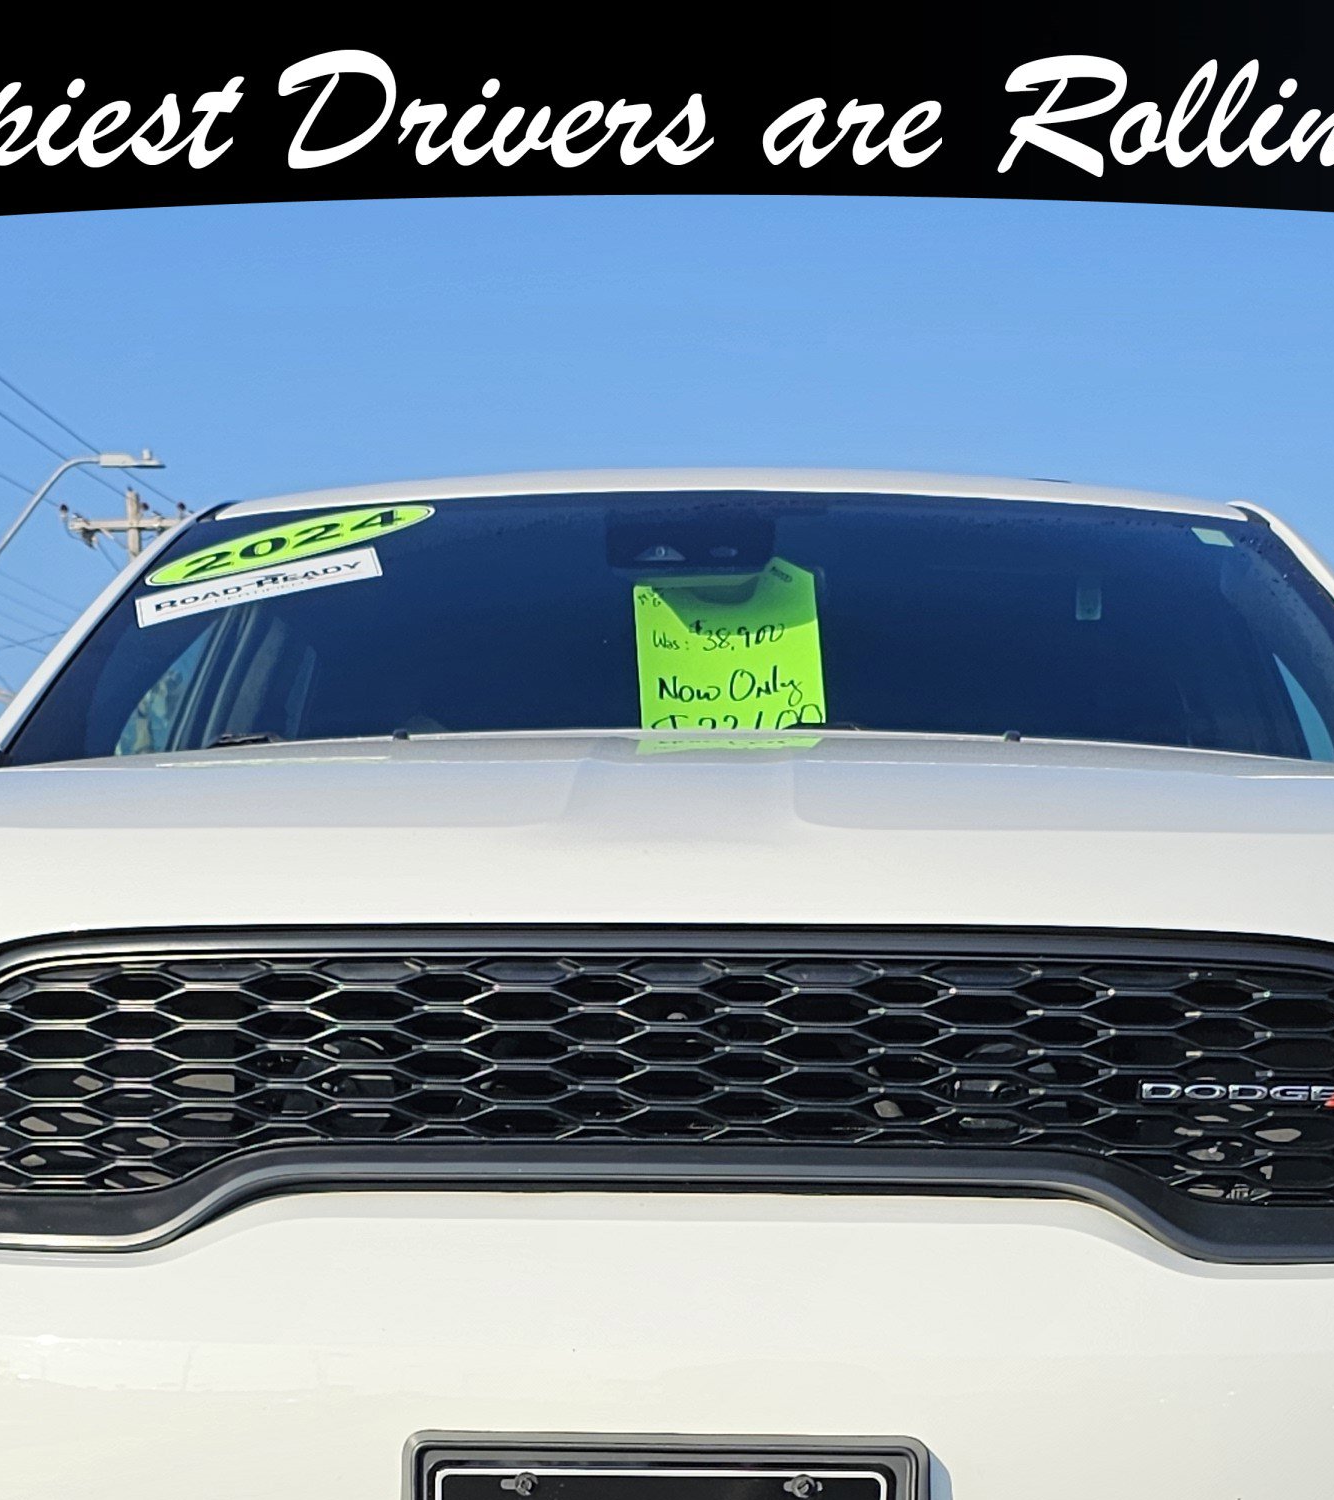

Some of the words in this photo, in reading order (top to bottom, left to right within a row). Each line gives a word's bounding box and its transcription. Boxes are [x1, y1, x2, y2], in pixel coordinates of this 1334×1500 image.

[183, 509, 404, 580] 2024
[154, 585, 240, 612] ROAD
[657, 675, 721, 703] Now
